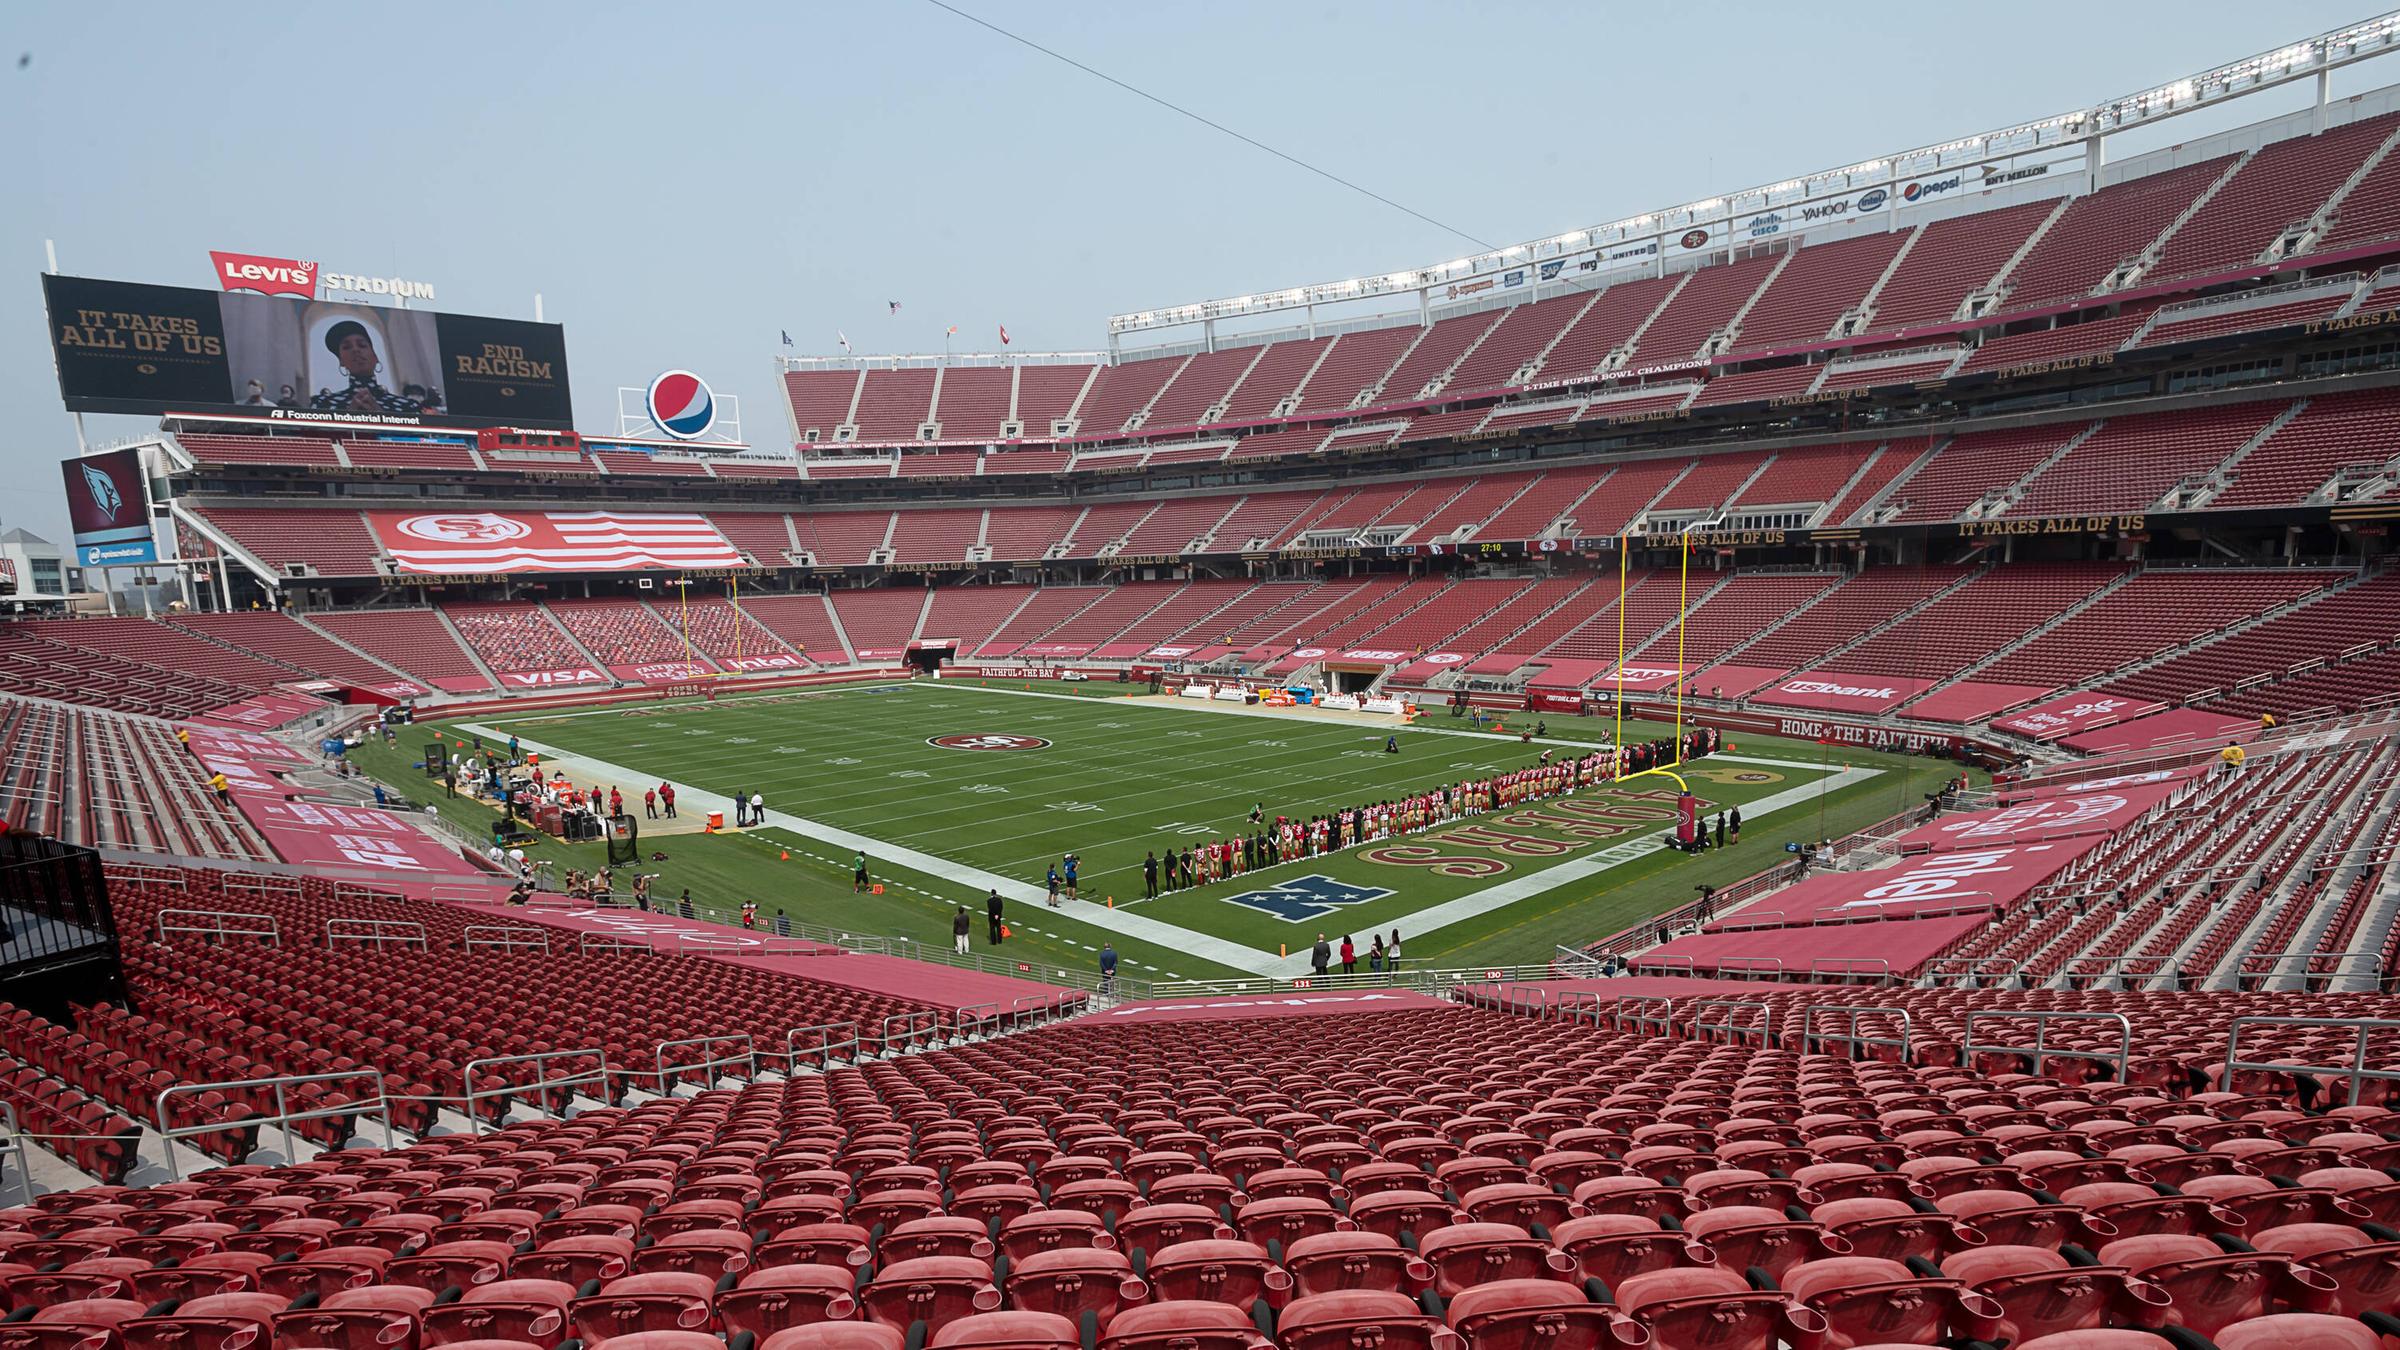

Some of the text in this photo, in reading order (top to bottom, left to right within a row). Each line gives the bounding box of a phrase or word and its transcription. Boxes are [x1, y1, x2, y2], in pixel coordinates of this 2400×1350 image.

[2007, 165, 2048, 182] MELLON
[1922, 176, 1960, 198] pepsi
[1802, 200, 1849, 221] YAHOO!
[1612, 247, 1646, 260] UNITED
[1541, 264, 1560, 278] SAP
[1580, 259, 1598, 272] nrg
[324, 272, 435, 300] STADIUM
[77, 309, 199, 335] IT TAKES
[2304, 322, 2322, 335] IT
[2326, 310, 2381, 331] TAKES
[60, 325, 222, 356] ALL OF US
[456, 343, 553, 379] END RACISM
[1999, 353, 2114, 379] IT TAKES ALL OF US
[1523, 358, 1713, 392] 5-TIME SUPER BOWL CHAMPIONS
[1769, 387, 1869, 408] IT TAKES ALL OF US
[287, 410, 332, 421] Foxconn
[334, 413, 381, 423] Industrial
[383, 415, 420, 425] Internet
[1959, 515, 2145, 537] IT TAKES ALL OF US
[1645, 536, 1659, 547] IT
[1711, 533, 1740, 546] ALL
[1743, 532, 1760, 544] OF
[1765, 531, 1785, 543] US
[1279, 548, 1361, 560] IT TAKES ALL OF US
[1481, 543, 1502, 552] 27:10
[682, 567, 778, 578] IT TAKES ALL OF US
[884, 562, 978, 573] IT TAKES ALL OF US
[380, 573, 509, 587] IT TAKES ALL OF US
[511, 669, 601, 684] VISA
[982, 667, 1018, 678] FAITHFUL
[1023, 668, 1038, 678] THE
[1039, 668, 1055, 678] BAY
[1822, 683, 1898, 699] bank
[1781, 719, 1823, 739] HOME
[1834, 727, 1864, 743] THE
